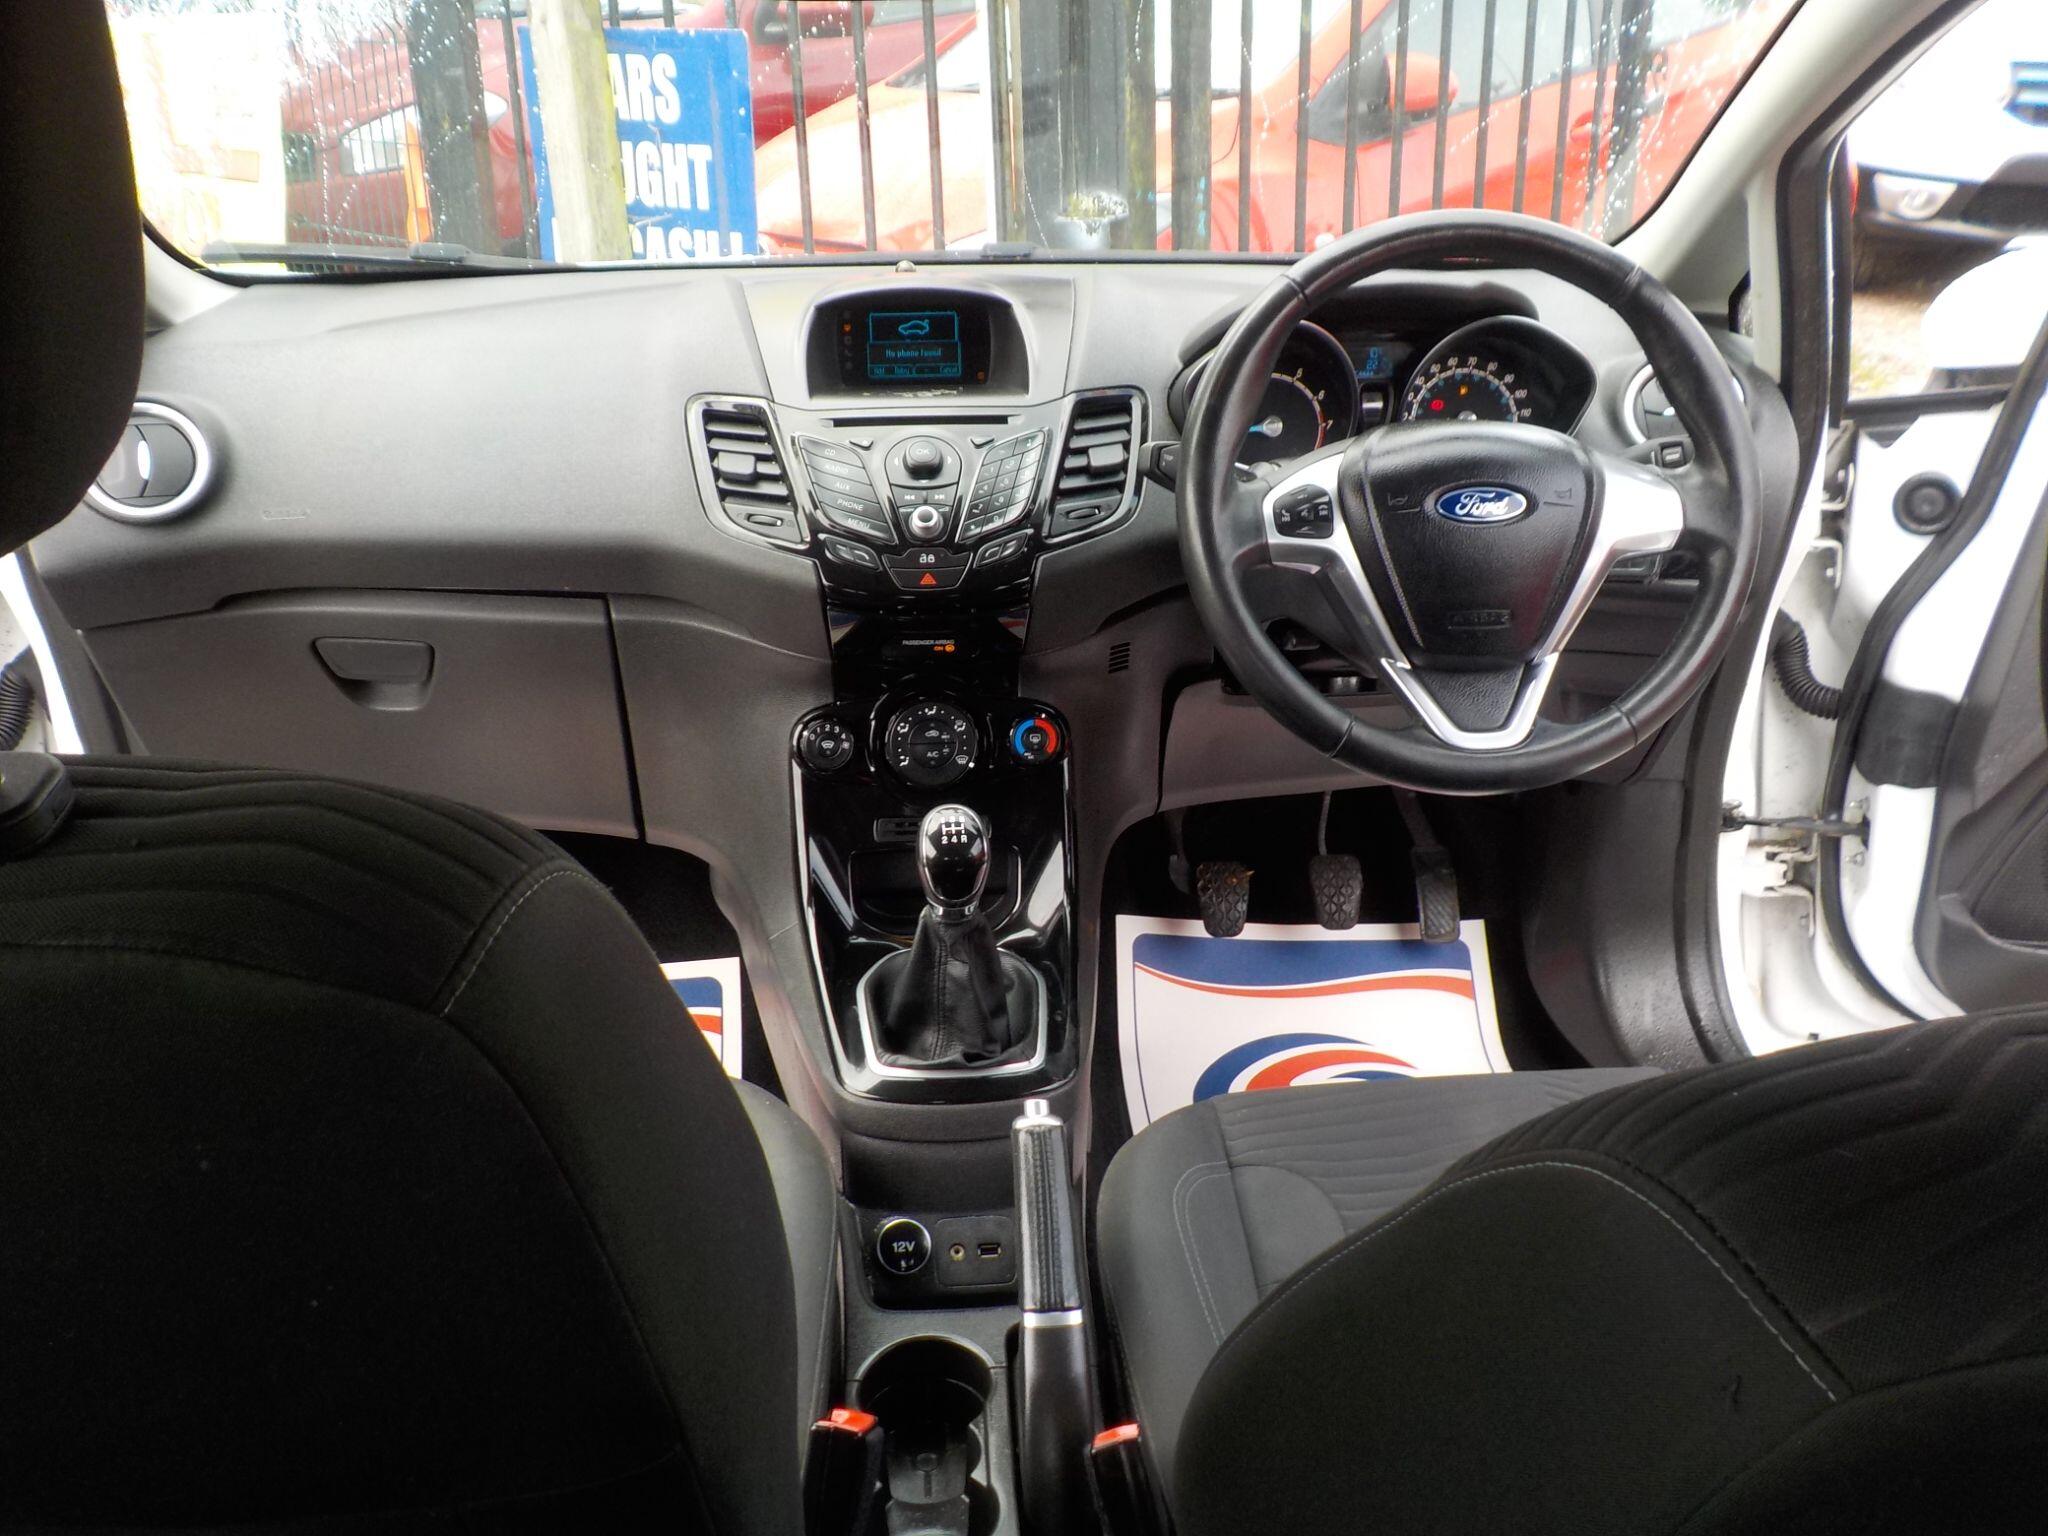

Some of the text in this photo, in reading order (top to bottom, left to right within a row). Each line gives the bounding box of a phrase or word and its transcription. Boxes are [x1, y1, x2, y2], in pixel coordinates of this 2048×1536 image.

[607, 53, 681, 124] ARS
[1466, 356, 1477, 366] 70
[1514, 389, 1528, 399] 100
[1520, 408, 1532, 418] 110
[1326, 420, 1333, 430] 7
[824, 448, 835, 456] CD
[825, 464, 849, 474] RADIO
[834, 481, 850, 490] AUX
[837, 499, 864, 511] PHONE
[1455, 492, 1510, 516] Ford
[847, 517, 870, 529] MENU
[834, 725, 840, 733] 3
[942, 835, 967, 844] 2 4 R
[892, 1241, 915, 1253] 12V
